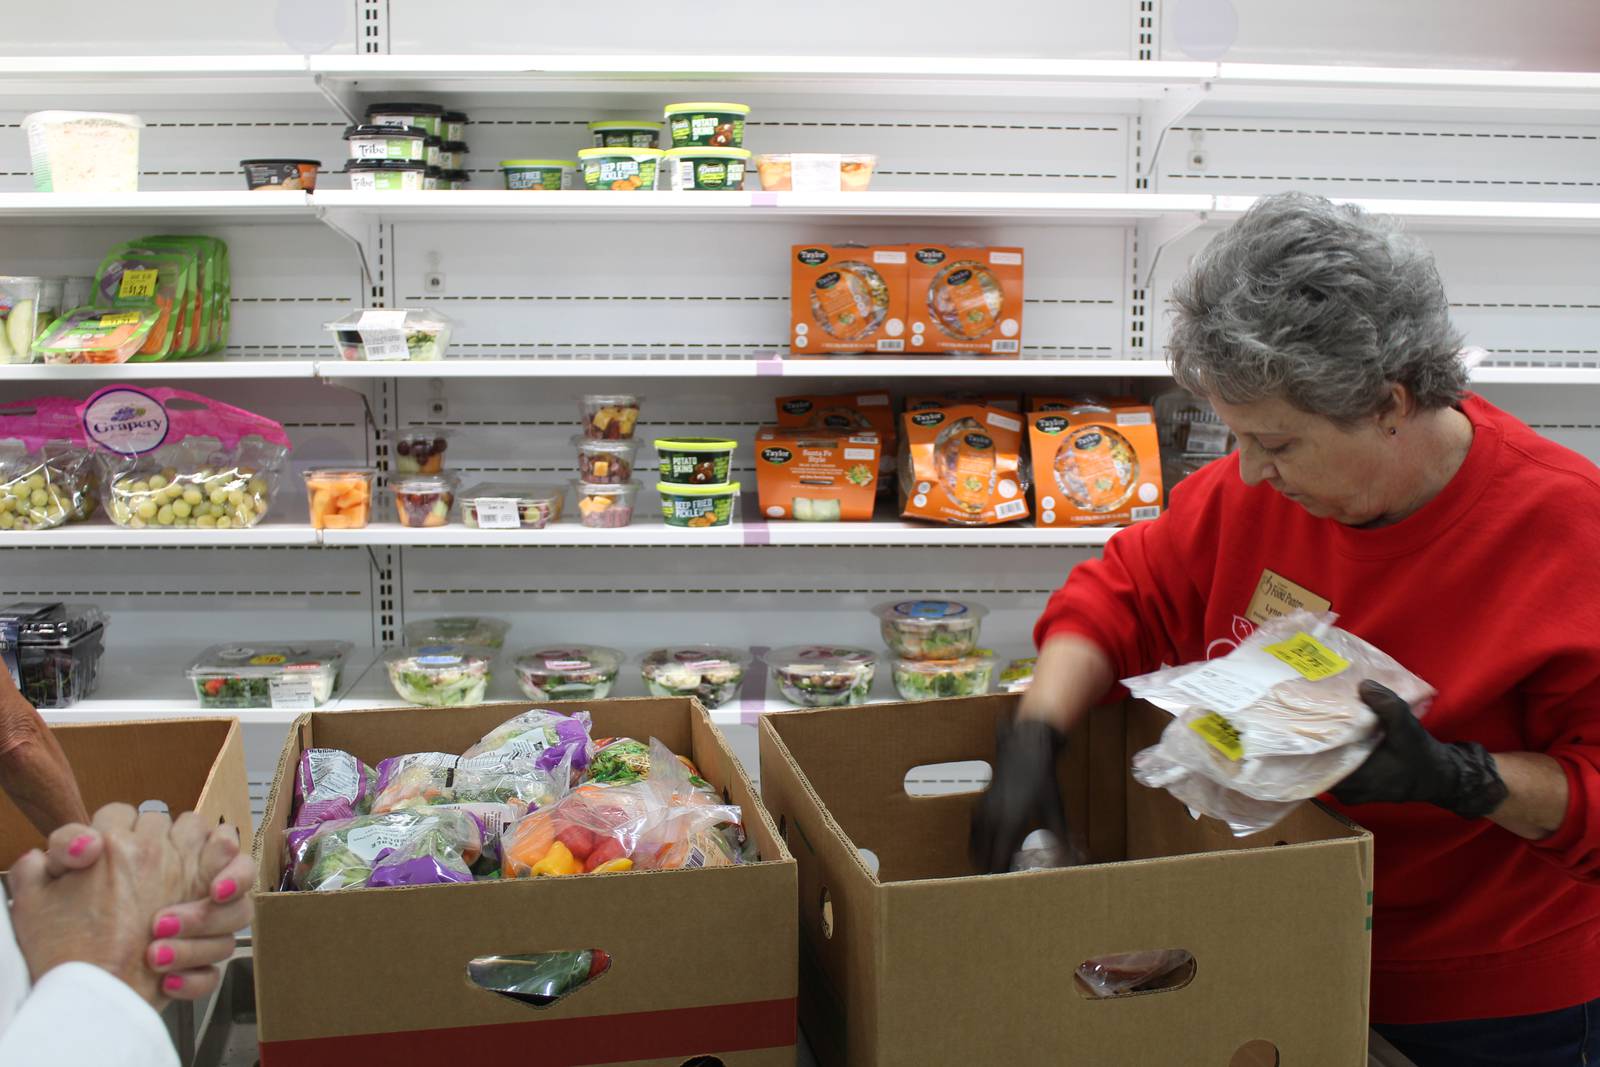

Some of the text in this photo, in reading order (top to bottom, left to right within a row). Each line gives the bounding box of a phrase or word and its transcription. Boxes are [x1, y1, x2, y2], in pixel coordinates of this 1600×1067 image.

[692, 118, 719, 128] POTATO
[358, 144, 385, 157] Tribe
[800, 250, 827, 259] Taylor
[917, 250, 943, 259] Taylor
[915, 413, 942, 421] Taylor
[94, 419, 161, 433] Grapery
[1038, 419, 1065, 429] Taylor
[765, 448, 790, 458] Taylor
[673, 457, 698, 466] POTATO
[673, 464, 694, 473] SKINS
[693, 498, 713, 508] FRIED
[1271, 584, 1305, 609] Food Pantry
[1265, 603, 1282, 617] Lynn
